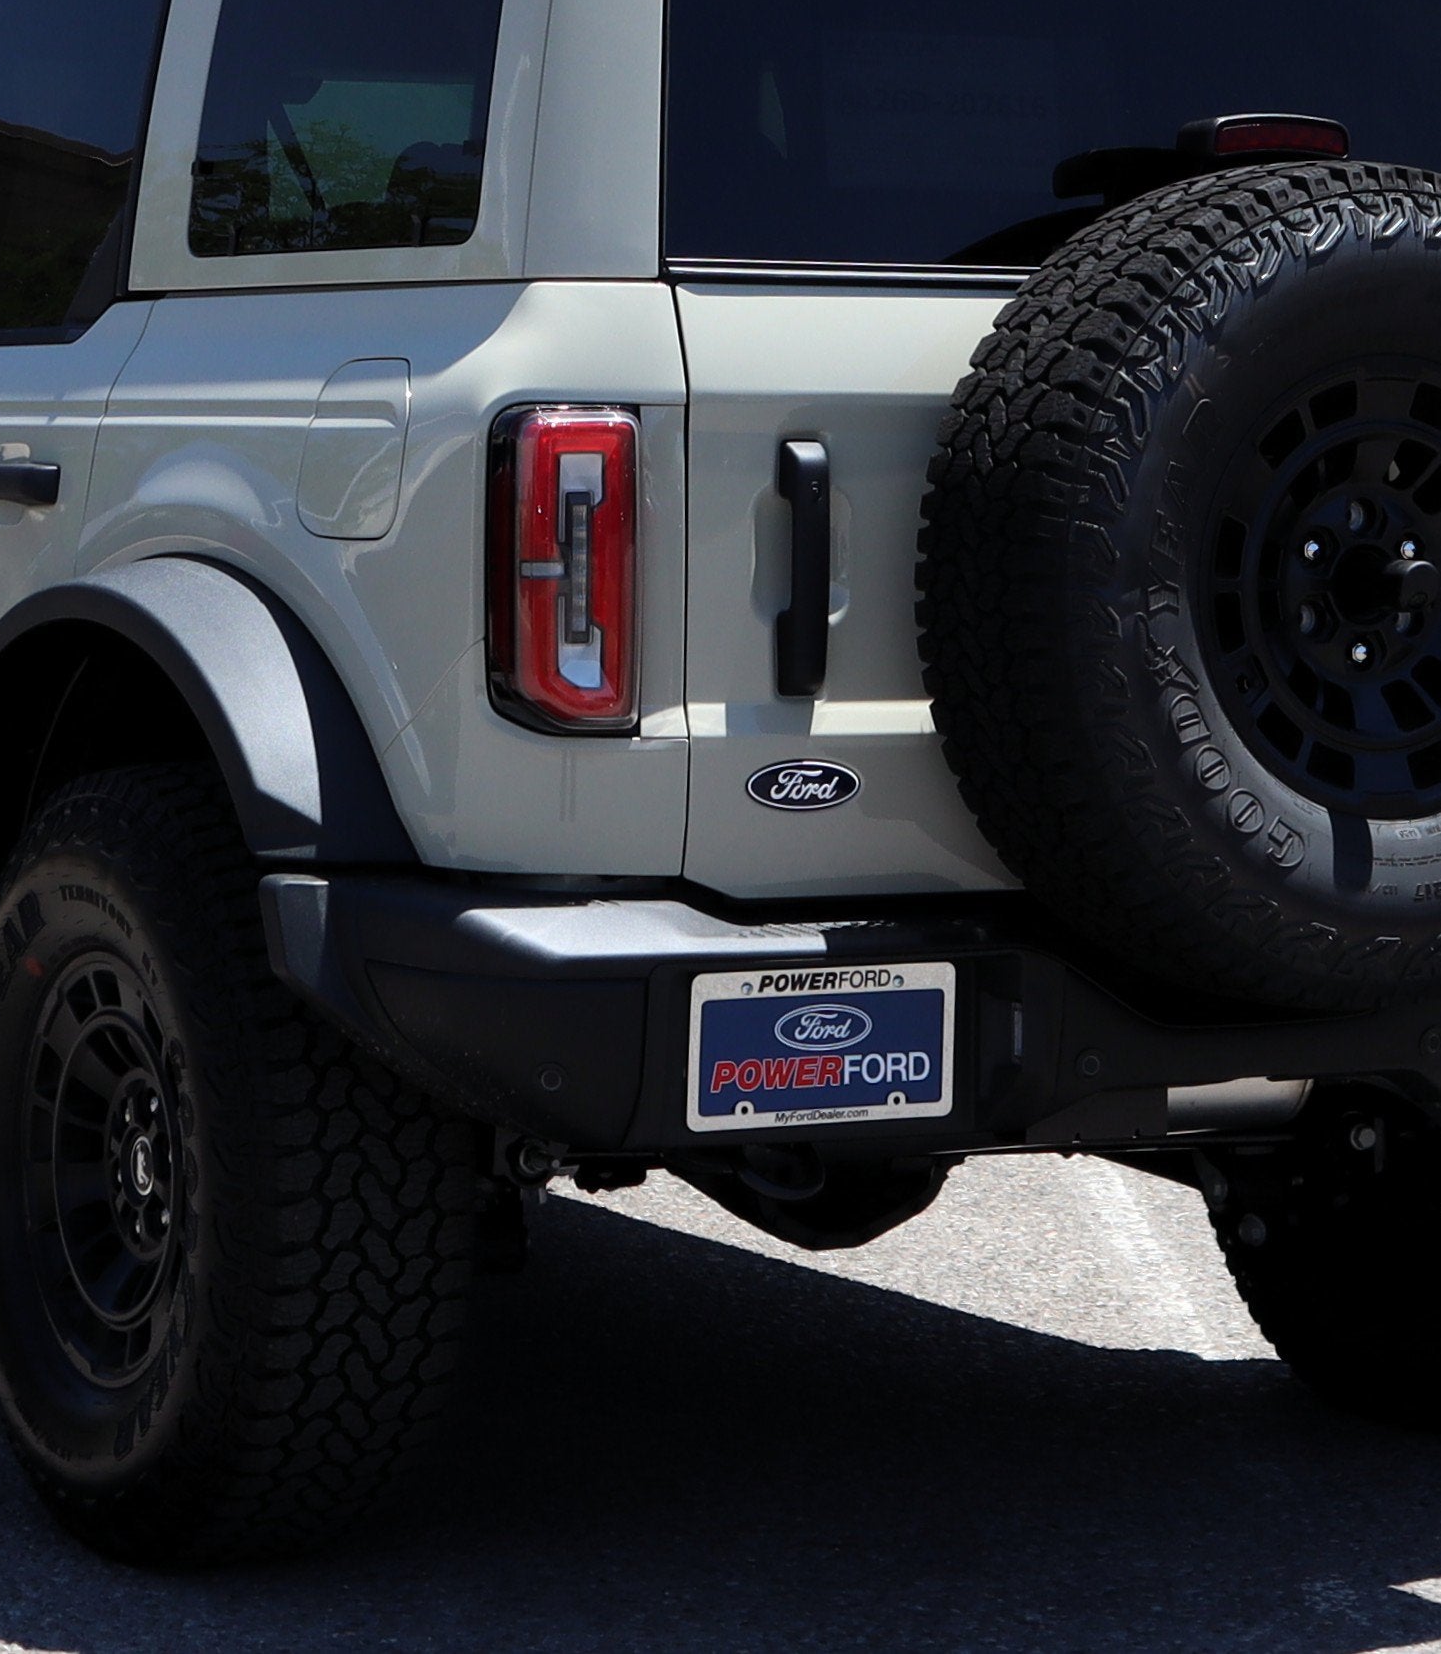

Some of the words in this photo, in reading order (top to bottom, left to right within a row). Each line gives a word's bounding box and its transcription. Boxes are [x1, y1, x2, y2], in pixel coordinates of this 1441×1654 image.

[770, 768, 840, 800] Ford
[757, 968, 891, 994] POWERFORD
[794, 1011, 852, 1041] Ford
[710, 1051, 931, 1094] POWERFORD
[774, 1107, 869, 1124] MyFordDealer.com
